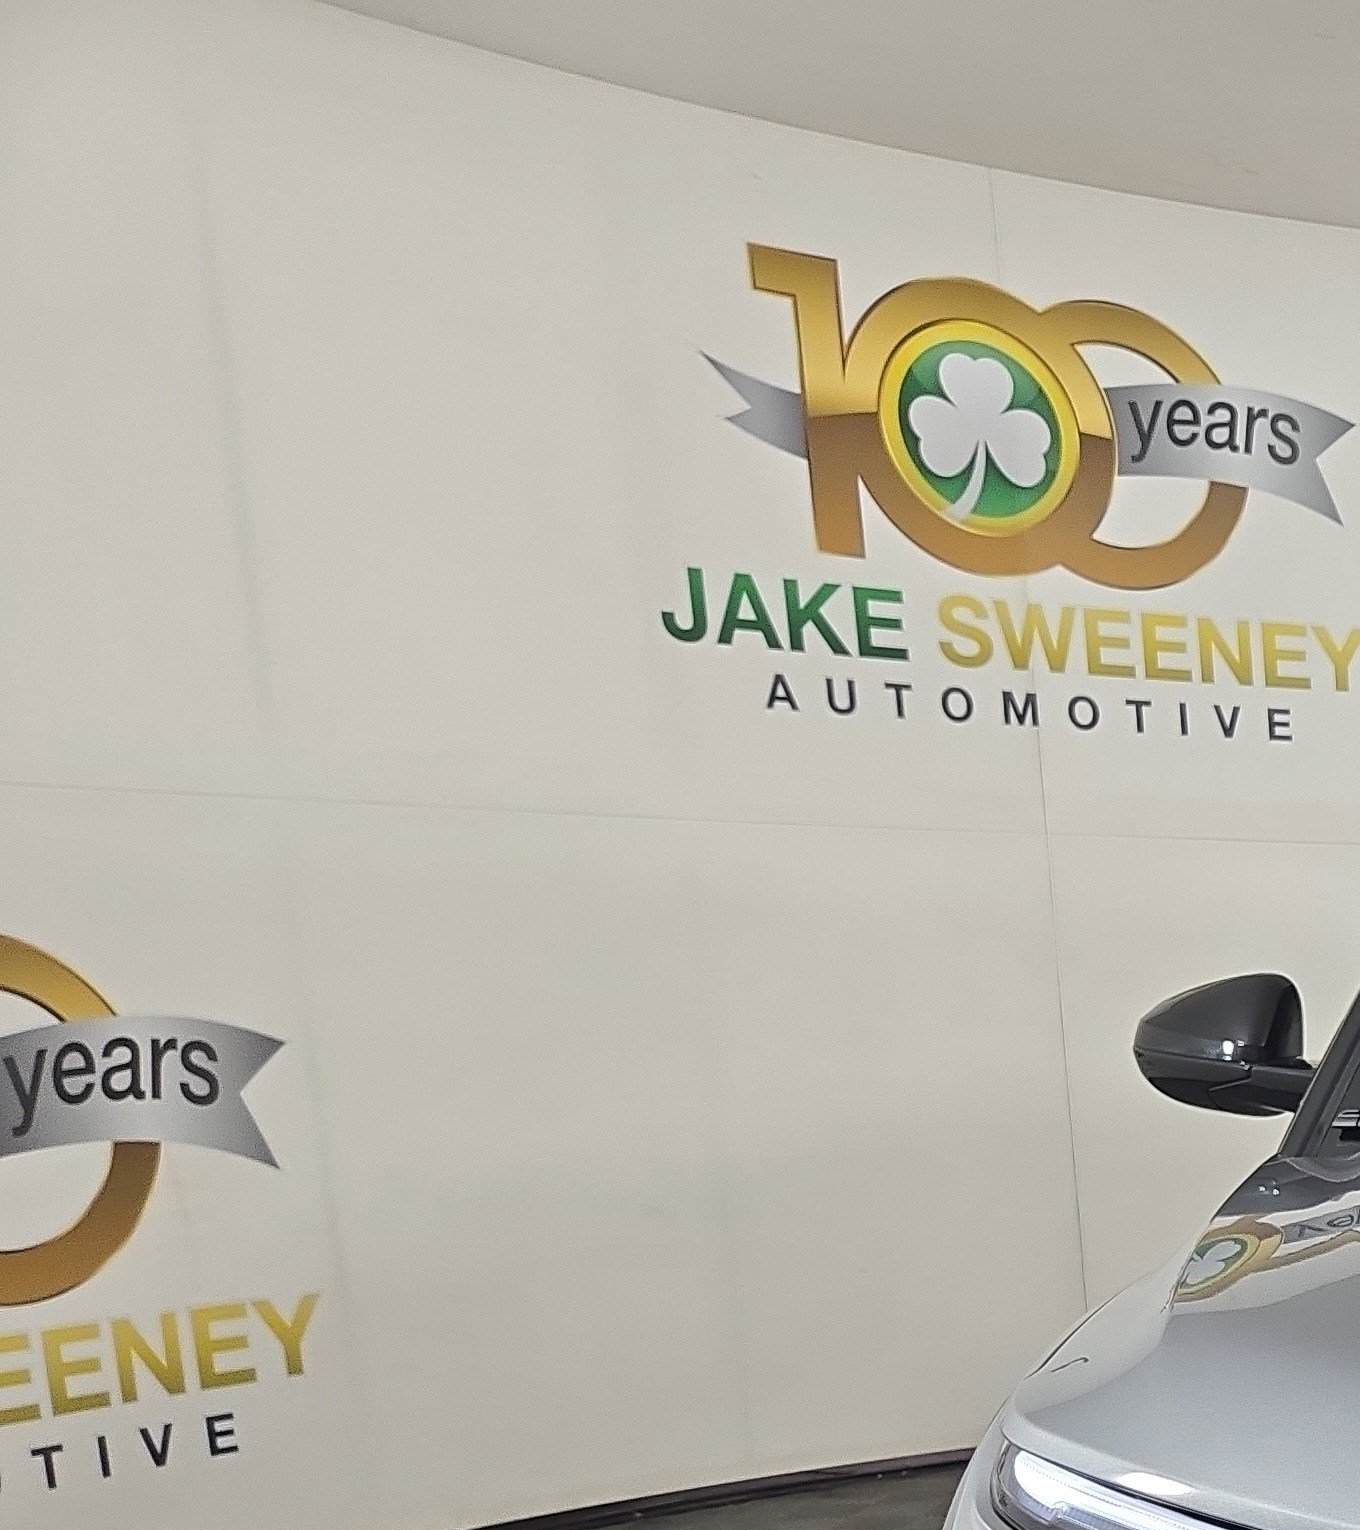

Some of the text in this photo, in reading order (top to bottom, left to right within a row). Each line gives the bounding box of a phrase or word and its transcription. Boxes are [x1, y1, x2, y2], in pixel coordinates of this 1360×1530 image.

[747, 242, 1301, 590] 100 years
[661, 567, 909, 661] JAKE
[767, 674, 1293, 741] AUTOMOTIVE
[2, 1037, 220, 1138] years
[0, 1413, 239, 1492] TIVE
